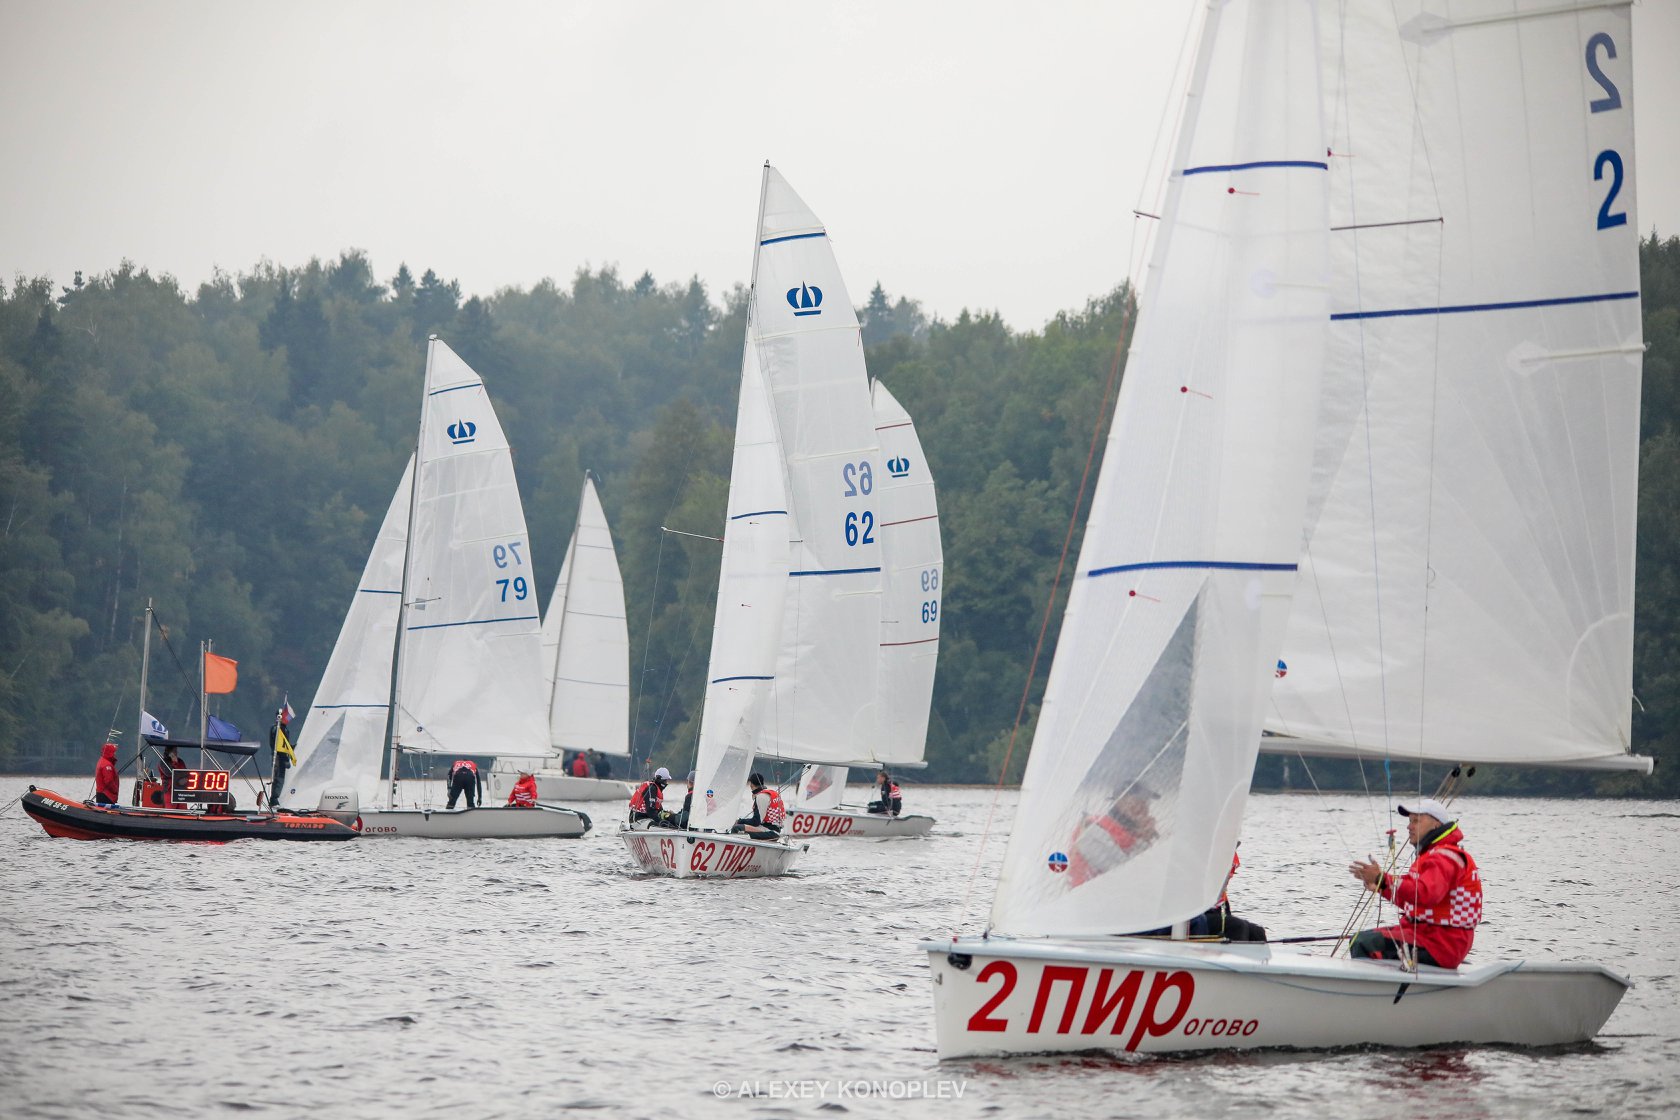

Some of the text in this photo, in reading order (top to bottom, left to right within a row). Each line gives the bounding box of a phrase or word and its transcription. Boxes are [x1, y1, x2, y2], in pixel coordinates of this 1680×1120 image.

[1594, 149, 1627, 231] 2
[845, 511, 874, 547] 62
[495, 576, 528, 602] 79
[921, 600, 938, 623] 69
[284, 822, 326, 830] TORNADO
[792, 814, 815, 834] 69
[660, 838, 677, 869] 62
[690, 841, 716, 872] 62
[967, 960, 1018, 1032] 2
